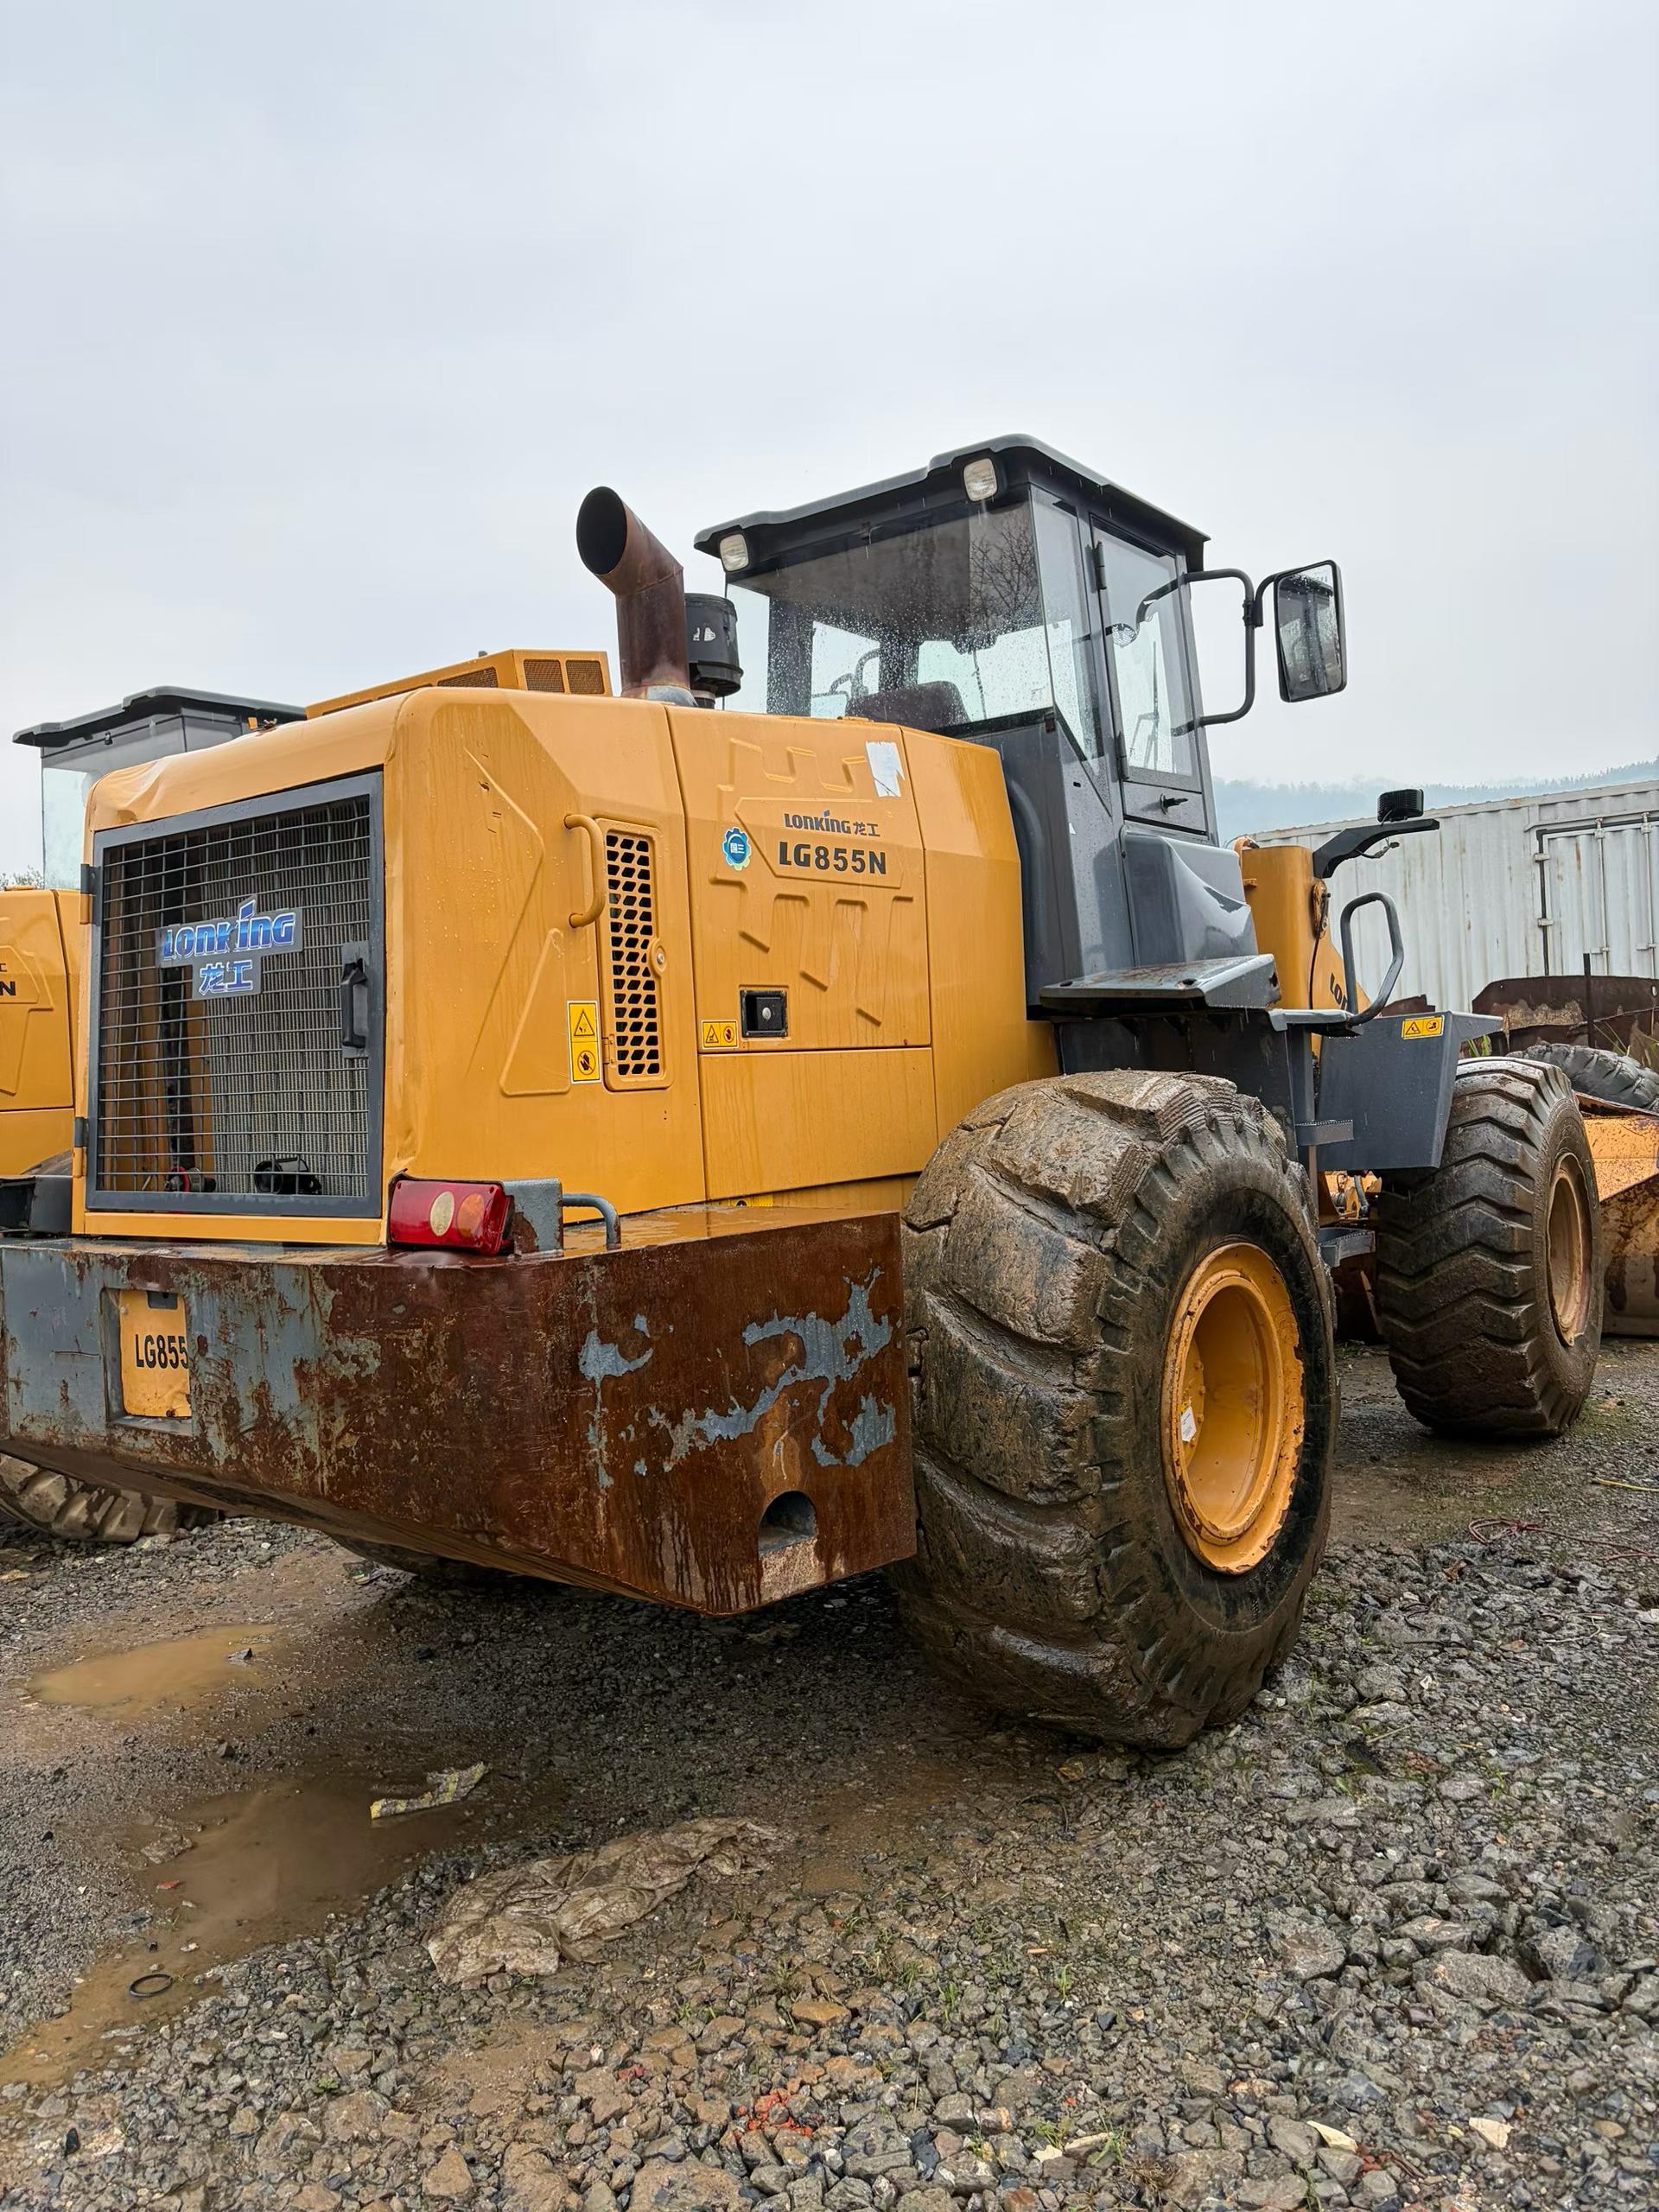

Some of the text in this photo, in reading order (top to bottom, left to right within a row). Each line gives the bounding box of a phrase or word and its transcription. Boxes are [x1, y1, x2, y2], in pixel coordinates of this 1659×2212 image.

[852, 821, 880, 837] 龙工
[779, 841, 887, 875] LG855N
[199, 959, 253, 995] 龙工
[135, 1333, 188, 1370] LG855
